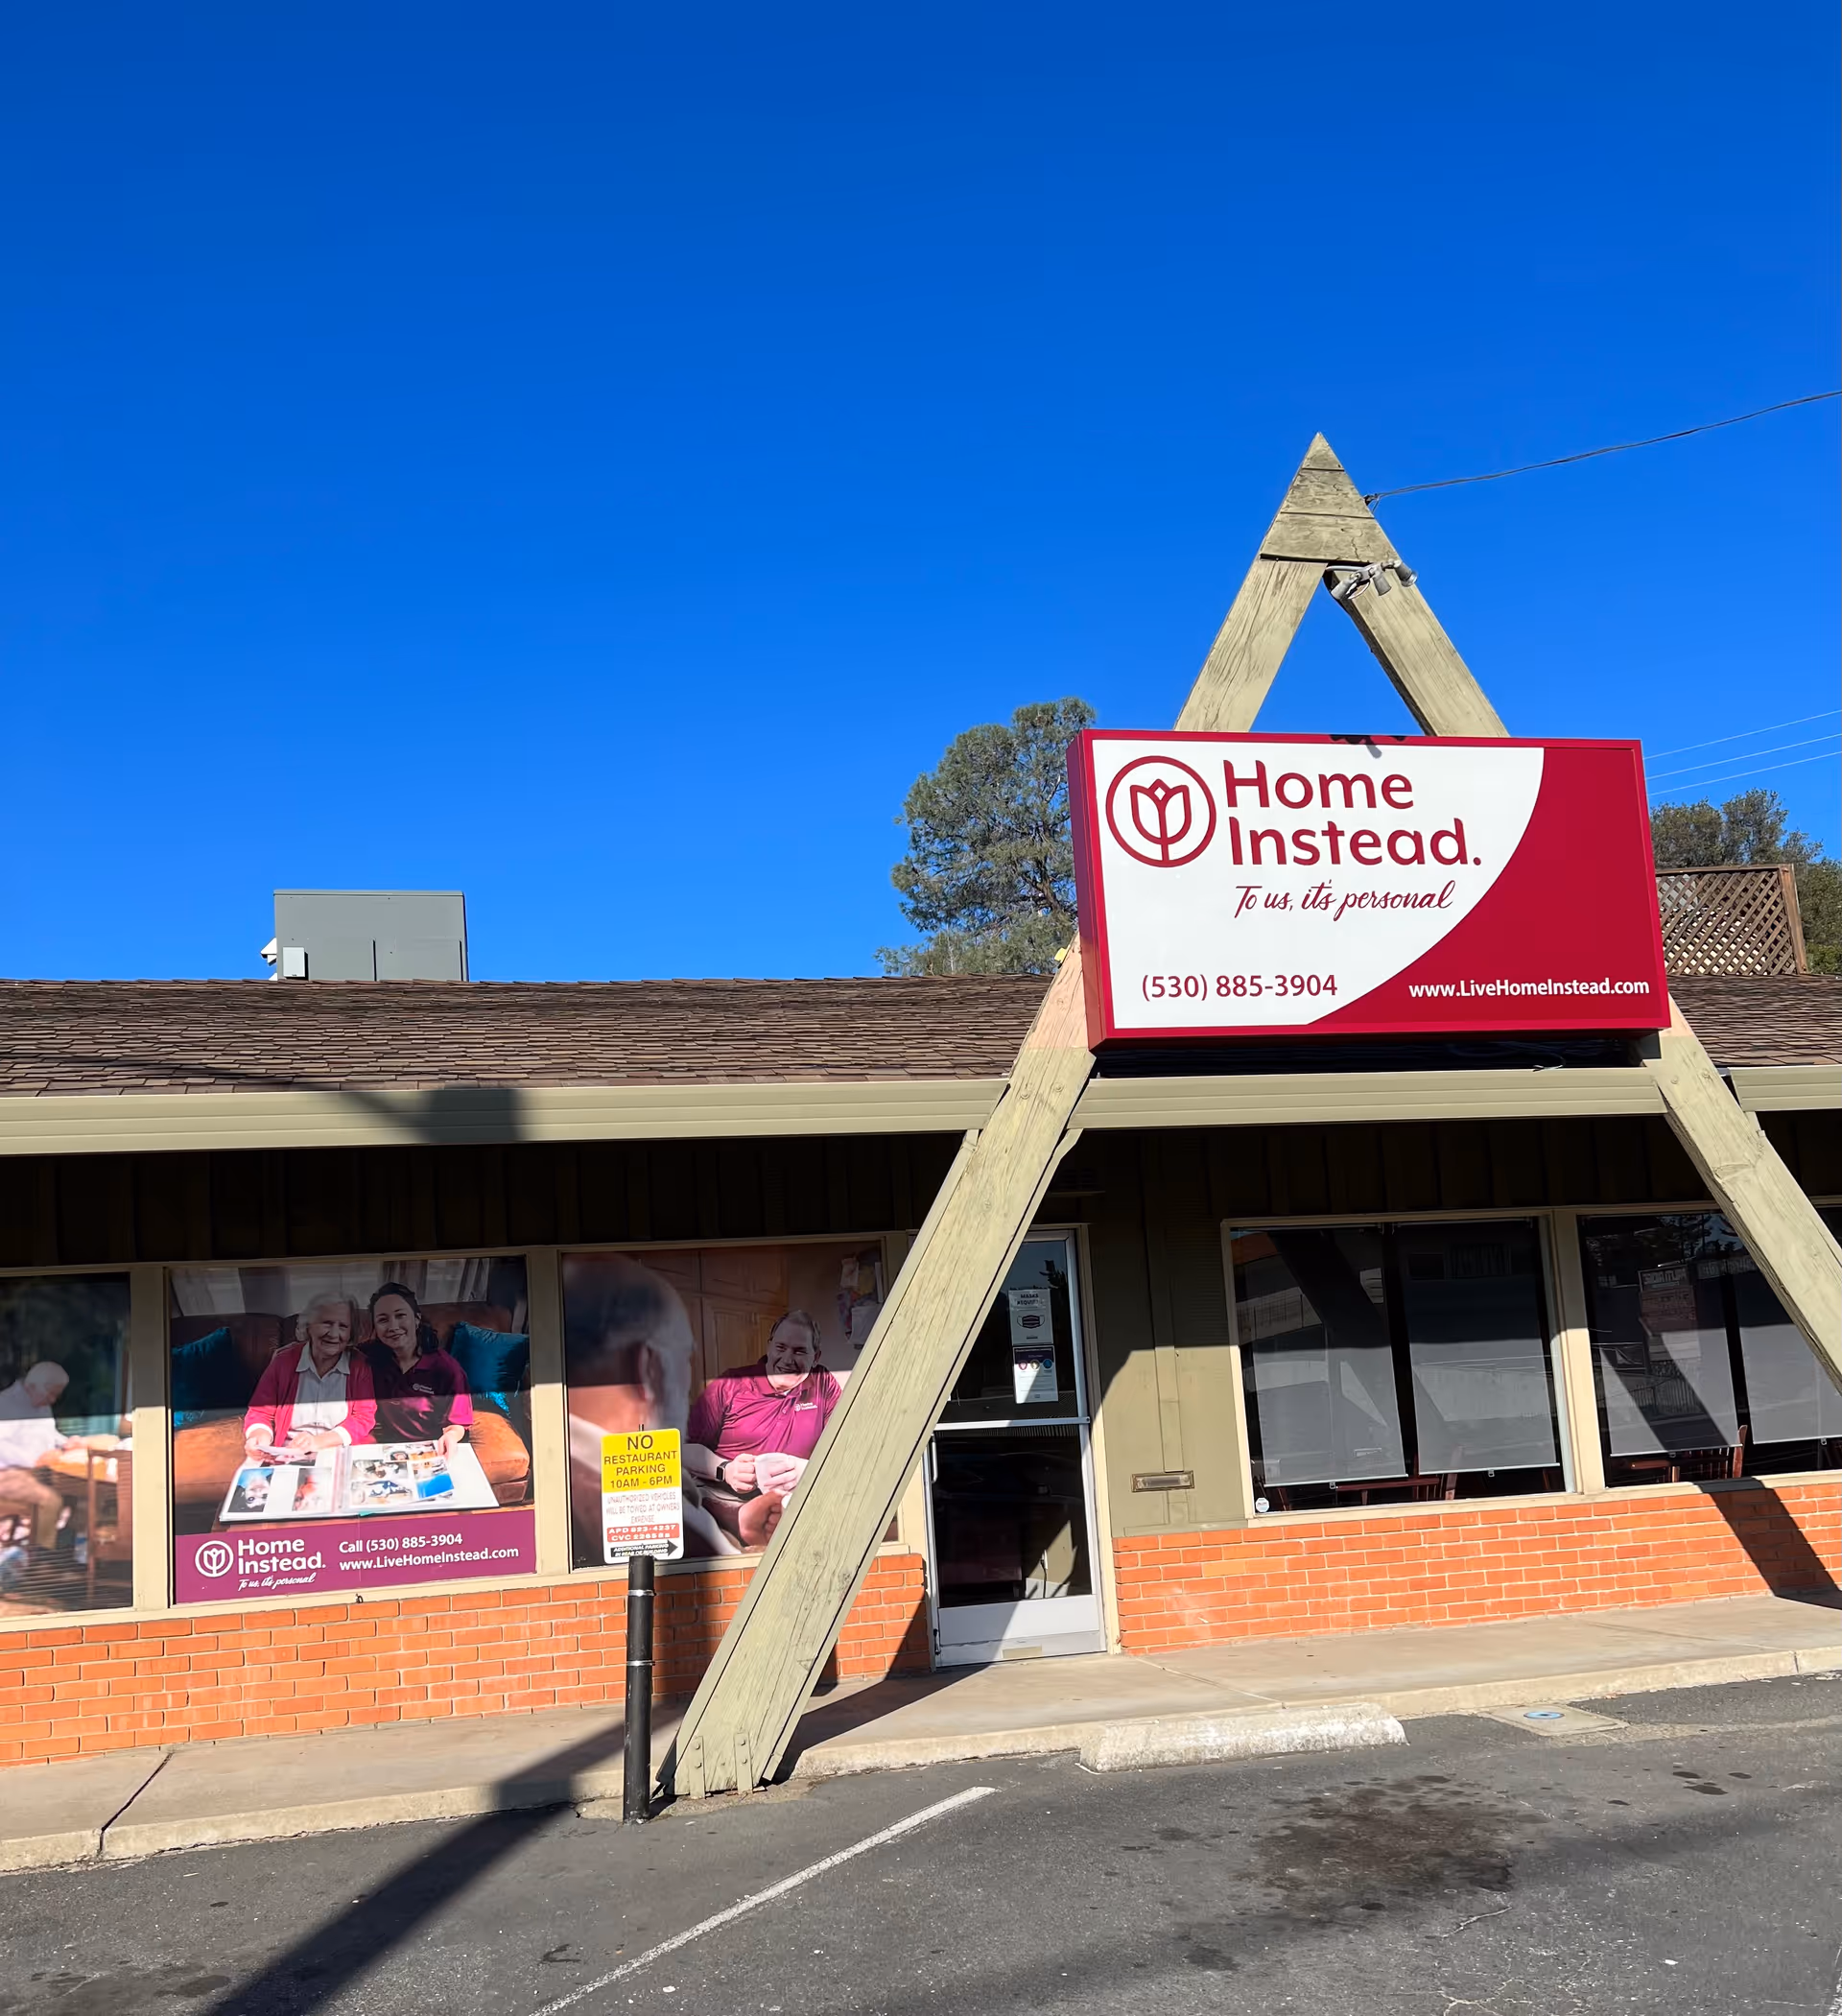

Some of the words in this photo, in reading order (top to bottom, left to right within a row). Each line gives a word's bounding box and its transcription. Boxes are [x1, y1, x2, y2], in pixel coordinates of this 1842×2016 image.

[1223, 759, 1414, 810] Home
[1228, 816, 1481, 866] Instead.
[1234, 886, 1263, 919] To
[1263, 891, 1294, 913] us,
[1301, 879, 1336, 911] it's
[1334, 879, 1456, 922] personal
[1142, 975, 1208, 1002] (530)
[1216, 974, 1338, 998] 885-3904
[1408, 977, 1650, 998] www.LiveHomeInstead.com
[626, 1435, 653, 1450] NO
[603, 1450, 677, 1465] RESTAURANT
[616, 1463, 666, 1477] PARKING
[610, 1478, 639, 1489] 10AM
[649, 1476, 673, 1486] 6PM
[607, 1493, 649, 1505] UNAUTHORIZED
[650, 1491, 676, 1502] VEHICLES
[619, 1506, 626, 1514] BE
[626, 1505, 647, 1513] TOWED
[648, 1504, 655, 1512] AT
[237, 1538, 305, 1556] Home
[339, 1539, 364, 1554] Call
[366, 1537, 399, 1554] (530)
[401, 1533, 463, 1549] 885-3904
[238, 1551, 327, 1575] Instead.
[339, 1547, 519, 1571] www.LiveHomeInstead.com
[237, 1578, 250, 1592] To
[272, 1572, 317, 1590] personal
